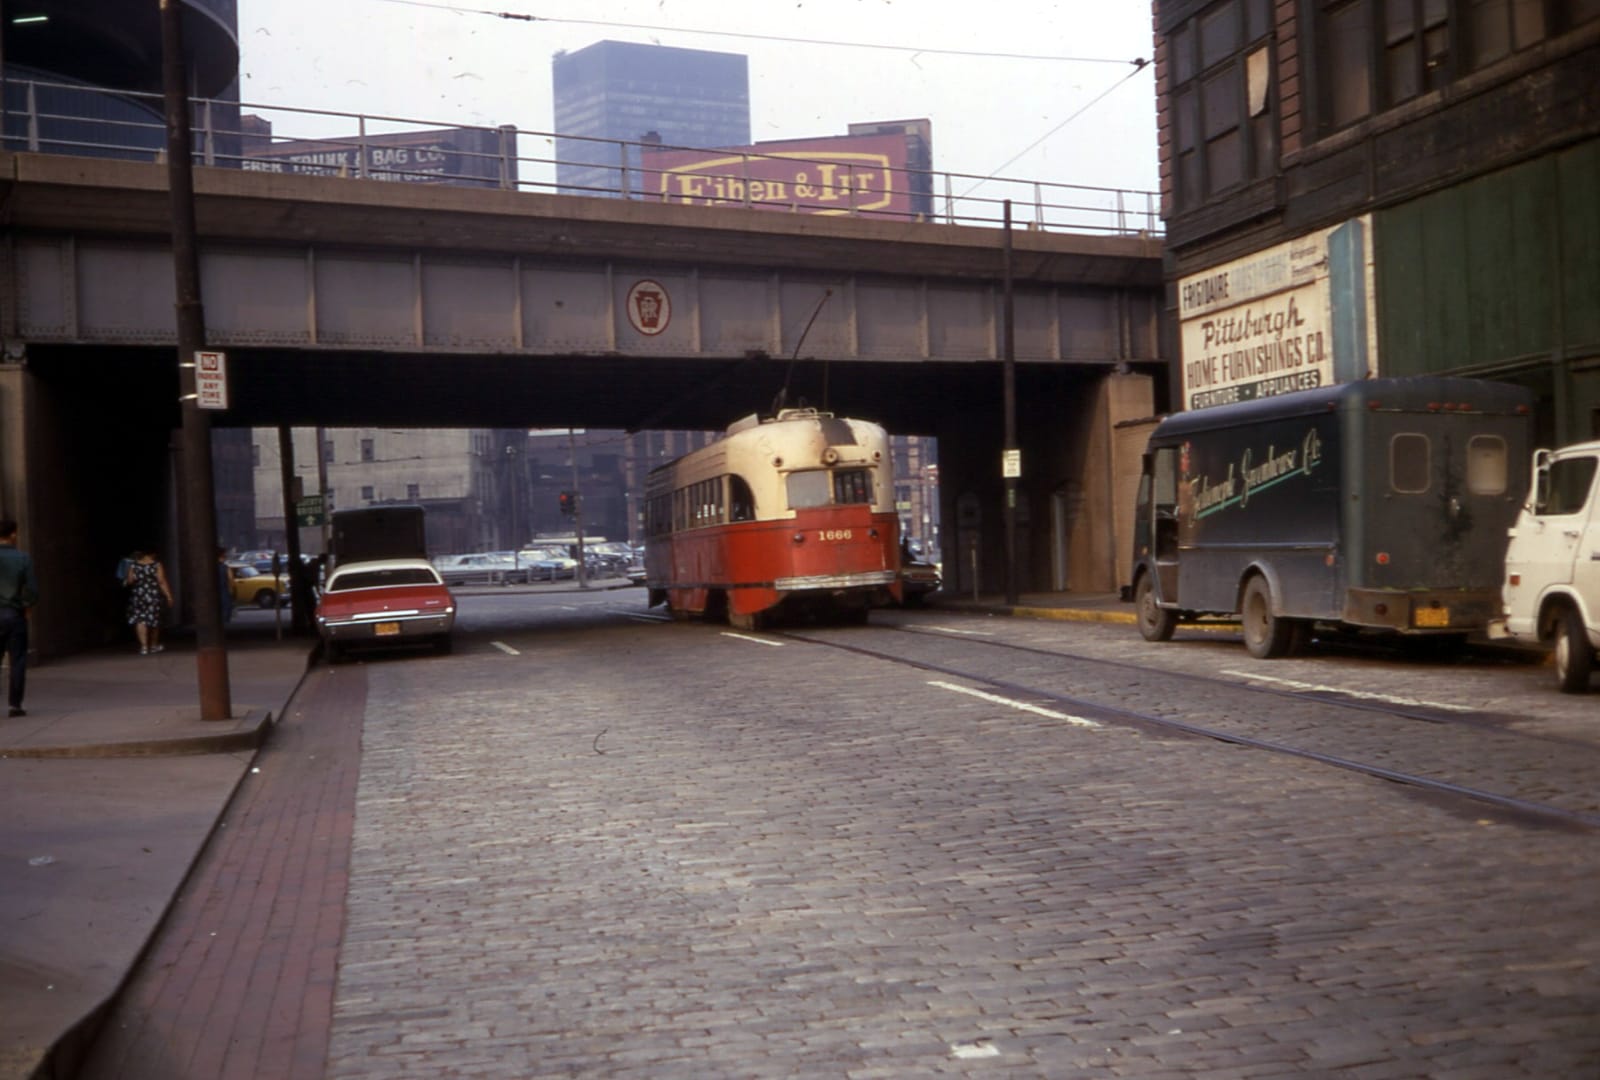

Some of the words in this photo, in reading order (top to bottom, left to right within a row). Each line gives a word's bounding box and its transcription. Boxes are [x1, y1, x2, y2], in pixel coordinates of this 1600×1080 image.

[372, 149, 408, 165] BAG
[795, 172, 818, 198] &
[1183, 272, 1229, 311] FRIGIDAIRE
[1202, 296, 1305, 350] Pittsburgh
[202, 356, 217, 368] NO
[1187, 355, 1218, 390] HOME
[1221, 336, 1303, 382] FURNISHINGS
[1307, 331, 1328, 364] CO.
[1193, 387, 1240, 409] FURNITURE
[1256, 371, 1318, 398] APPLIANCES
